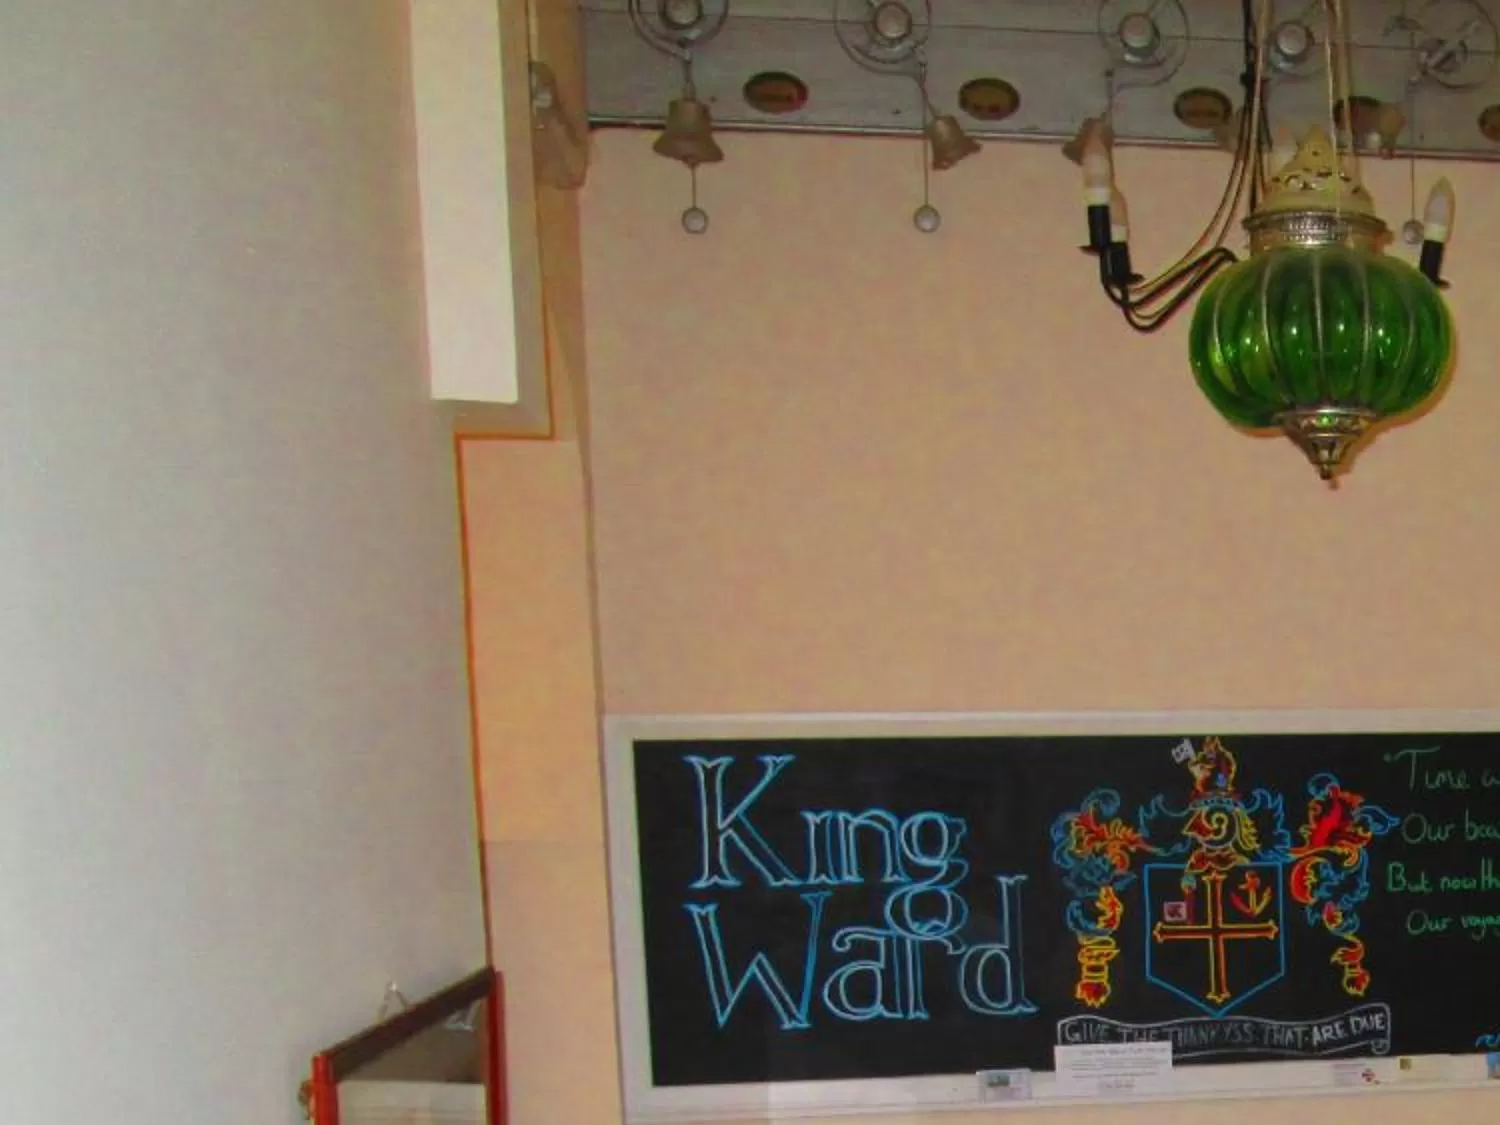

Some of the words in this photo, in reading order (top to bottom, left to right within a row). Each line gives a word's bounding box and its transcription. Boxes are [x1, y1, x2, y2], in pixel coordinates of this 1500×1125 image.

[1400, 811, 1456, 845] Our
[682, 753, 970, 939] King
[1385, 860, 1433, 895] But
[1439, 874, 1477, 891] now
[1406, 908, 1454, 935] Our
[682, 875, 1040, 1031] Ward
[1064, 1021, 1110, 1043] GIVE
[1311, 1021, 1348, 1047] ARE
[1349, 1012, 1387, 1036] DUE
